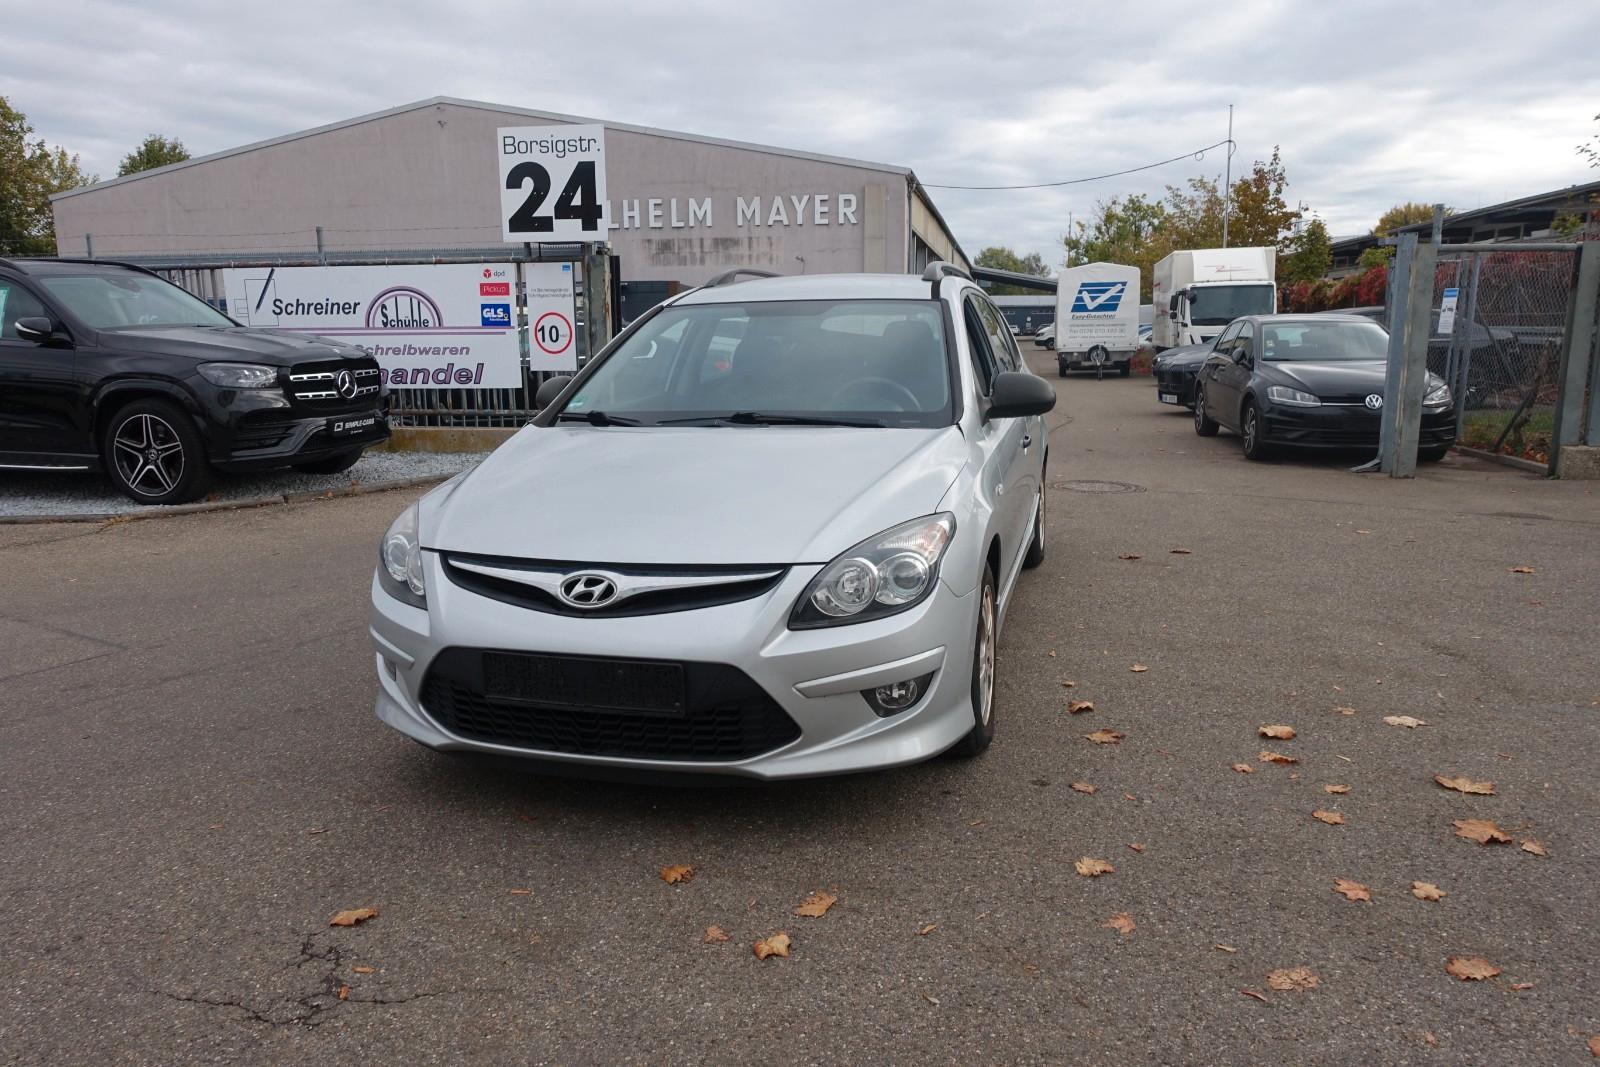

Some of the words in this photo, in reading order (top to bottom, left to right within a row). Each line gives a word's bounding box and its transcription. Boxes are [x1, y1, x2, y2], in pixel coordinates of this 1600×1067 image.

[503, 135, 601, 158] Borsigstr.
[506, 160, 603, 233] 24
[736, 193, 859, 227] MAYER
[483, 285, 506, 294] Pickup
[272, 298, 361, 316] Schreiner
[381, 296, 430, 328] Schühle
[482, 308, 504, 318] GLS
[537, 325, 560, 343] 10
